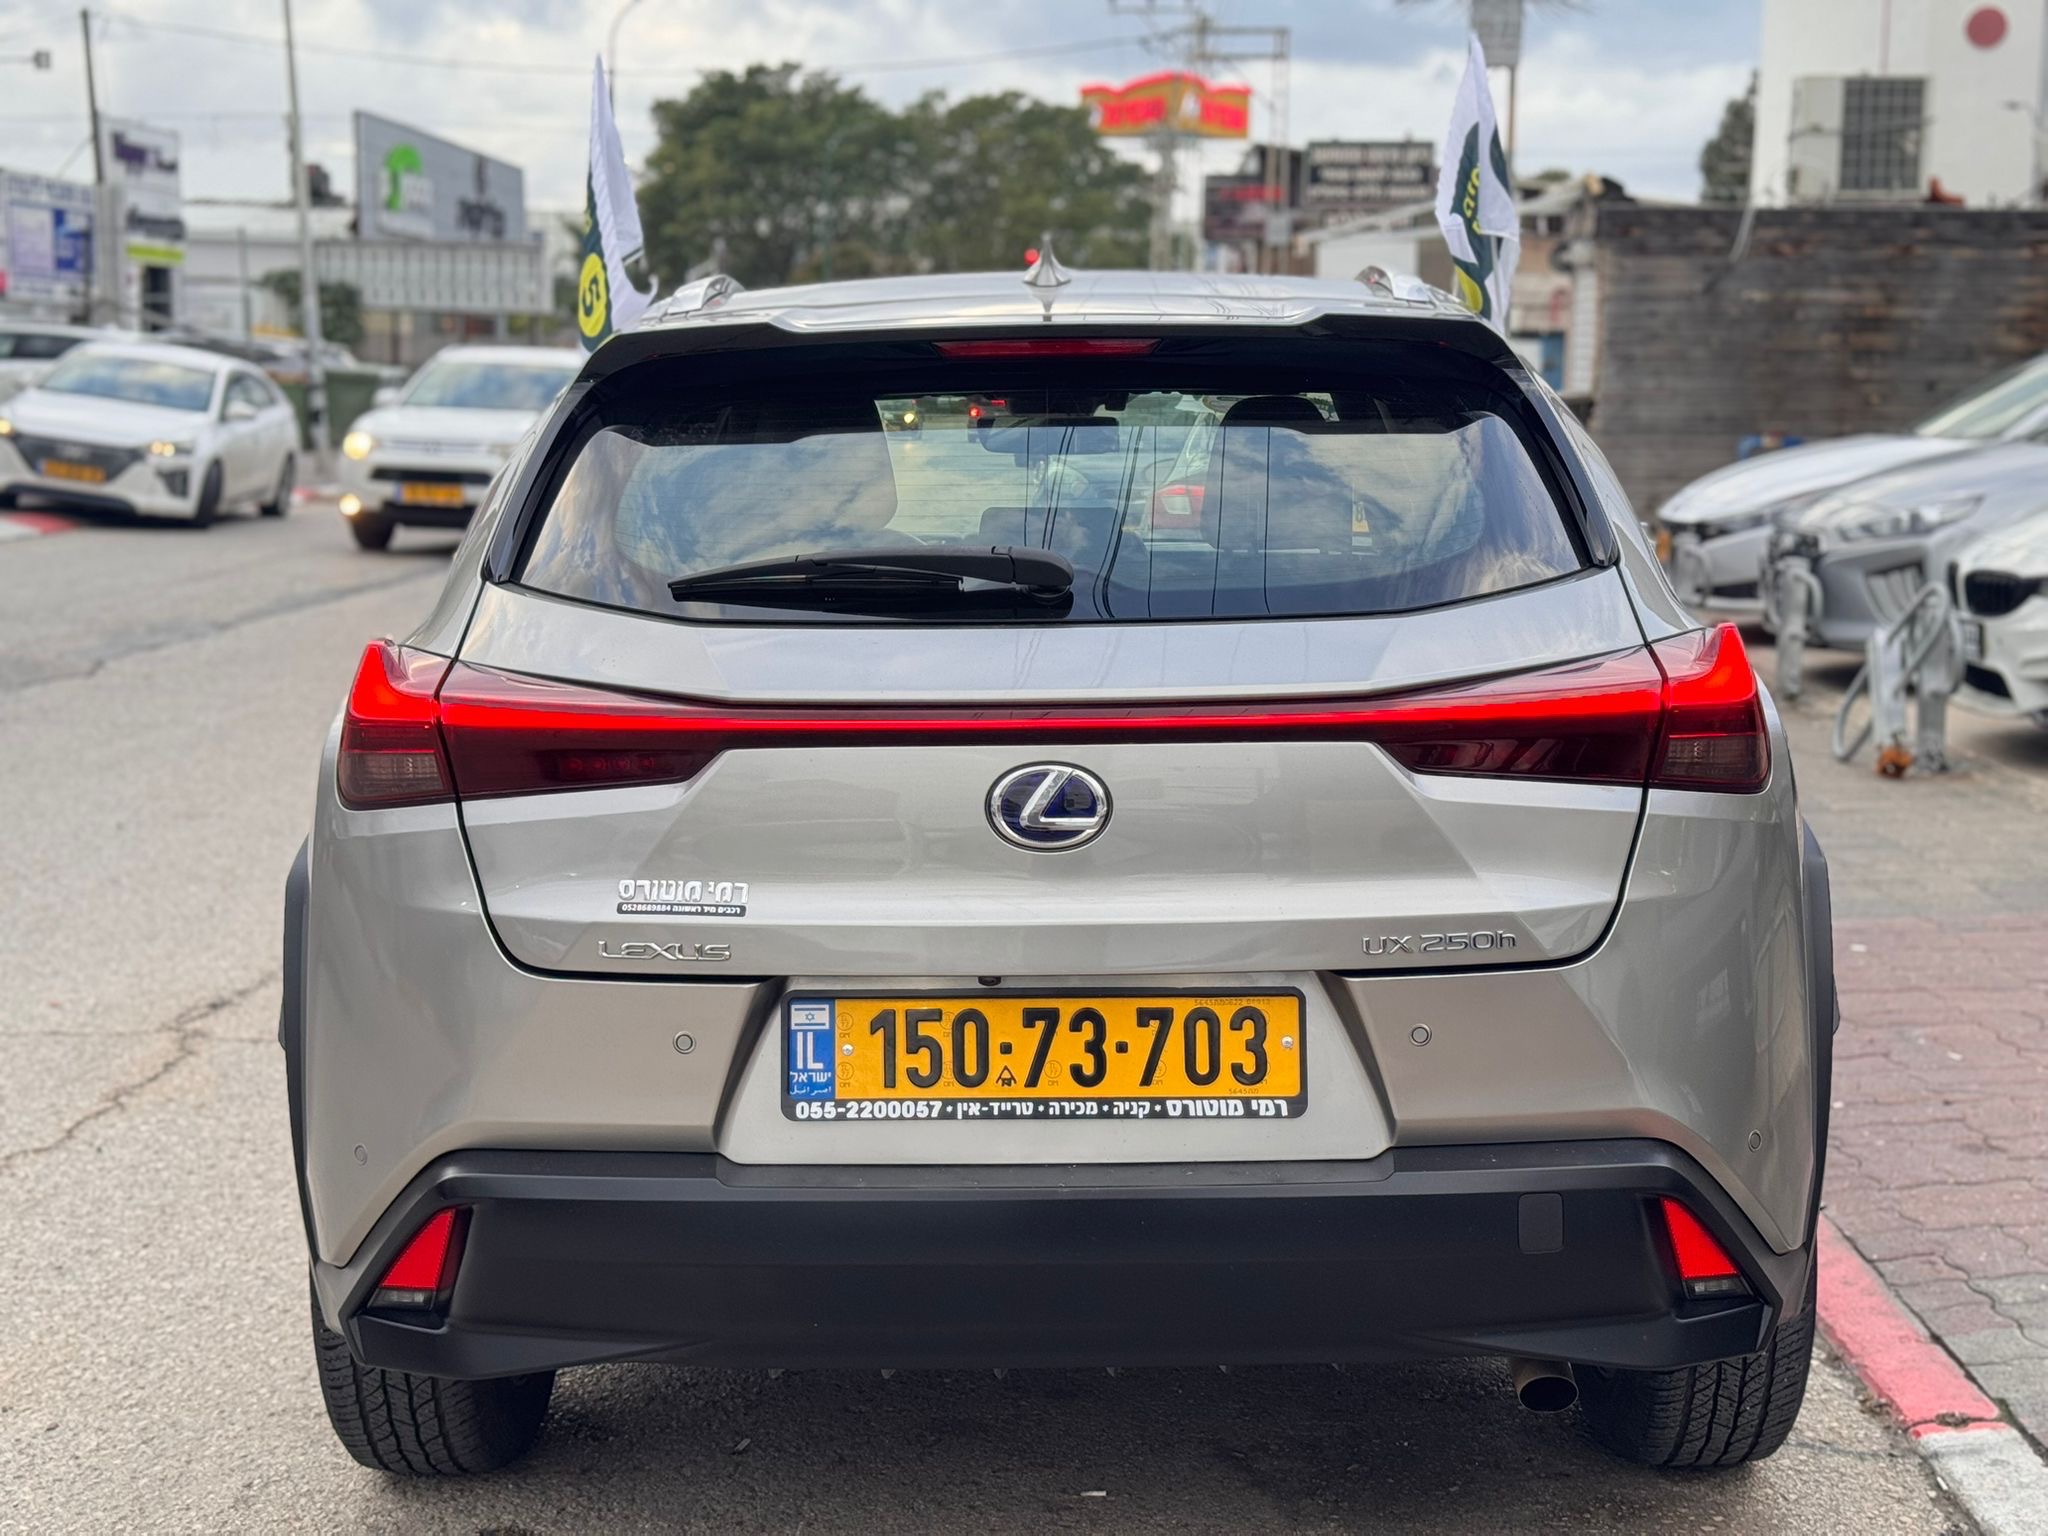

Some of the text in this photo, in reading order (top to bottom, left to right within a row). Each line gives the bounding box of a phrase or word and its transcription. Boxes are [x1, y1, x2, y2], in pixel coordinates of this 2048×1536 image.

[618, 879, 749, 903] רמי מוטורס
[598, 940, 732, 962] LEXUS
[1362, 930, 1517, 956] UX 250h
[796, 1031, 825, 1070] IL
[789, 1071, 832, 1083] ישראל
[795, 1100, 942, 1119] 055-2200057
[1049, 1101, 1098, 1116] מכירה
[1113, 1101, 1151, 1119] קניה
[1165, 1099, 1245, 1117] מוטורס
[1251, 1099, 1289, 1117] רמי
